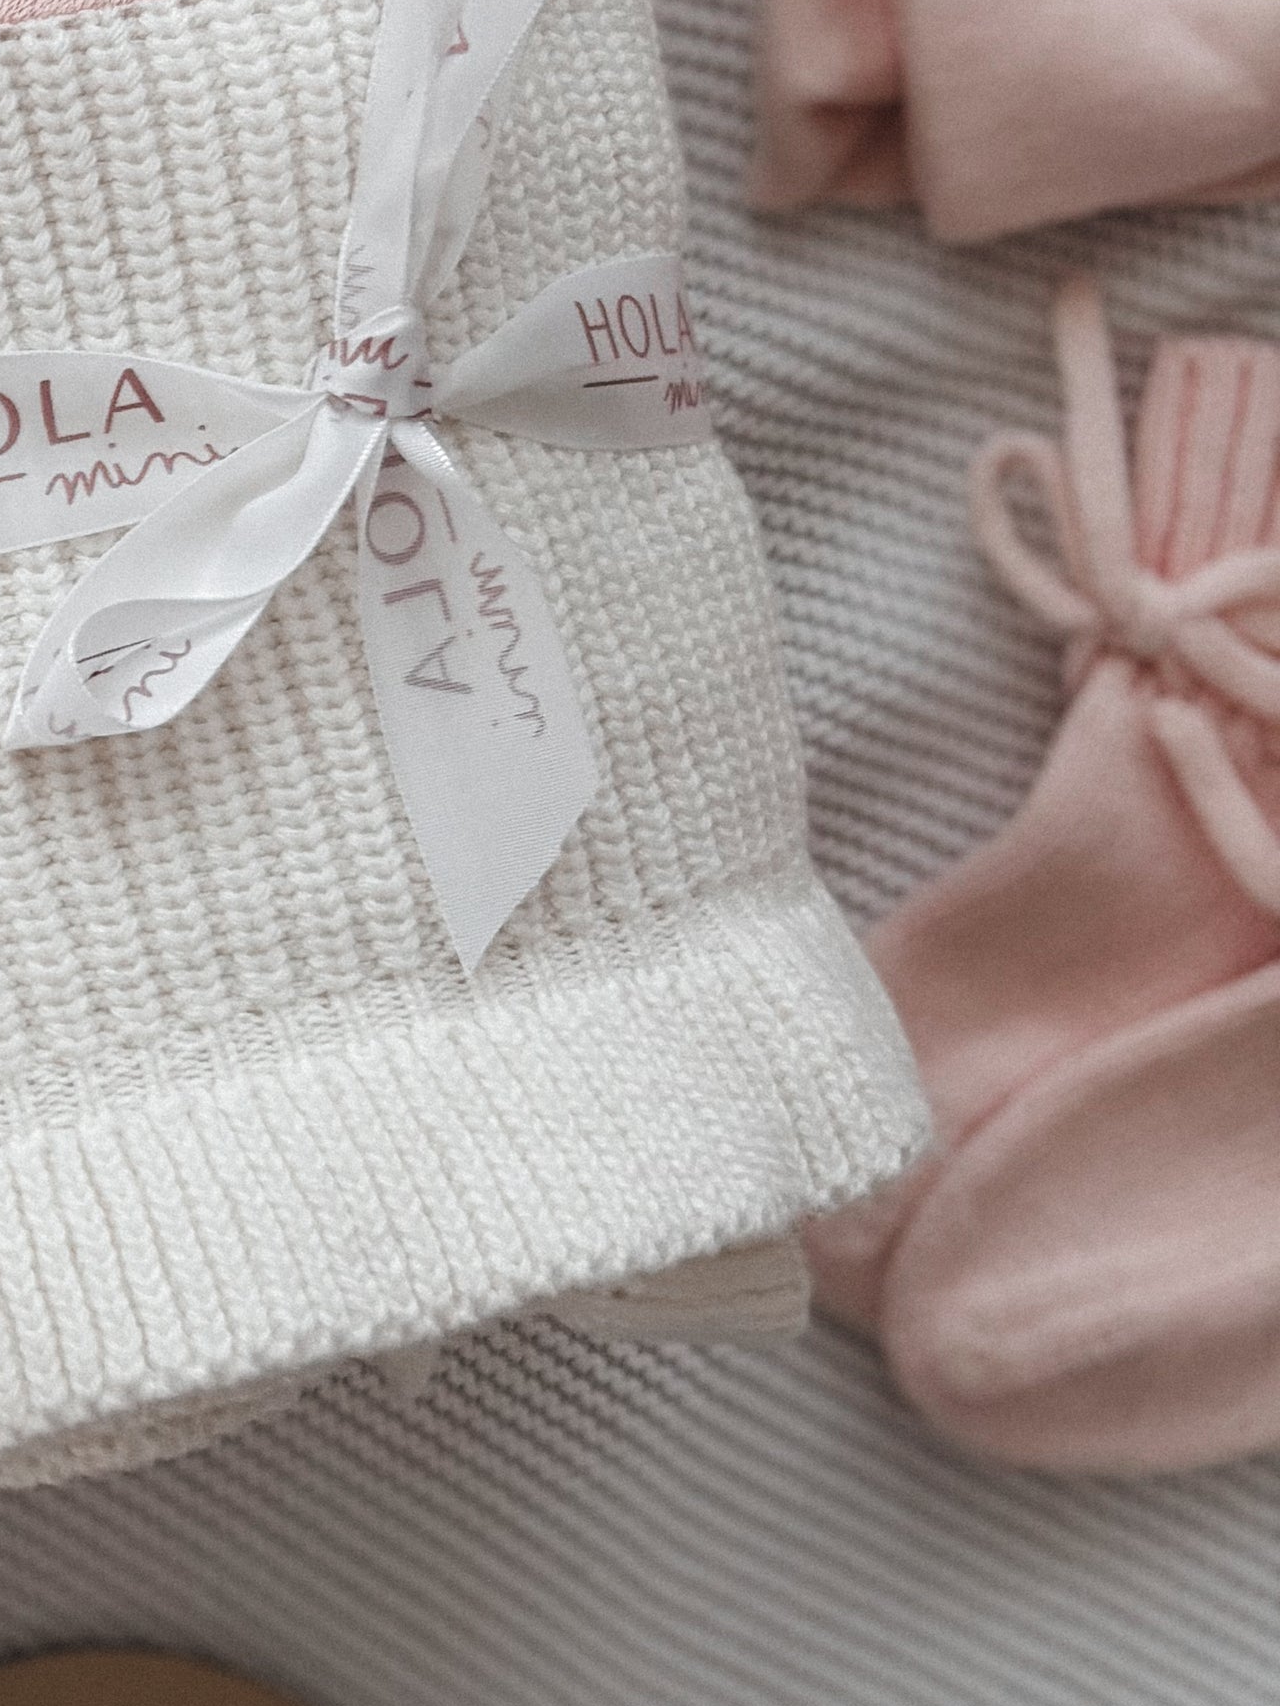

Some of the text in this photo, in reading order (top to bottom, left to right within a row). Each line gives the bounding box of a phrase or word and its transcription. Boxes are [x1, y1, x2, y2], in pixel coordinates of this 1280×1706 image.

[575, 292, 696, 364] HOLA
[44, 424, 240, 505] mini
[468, 550, 547, 731] mini
